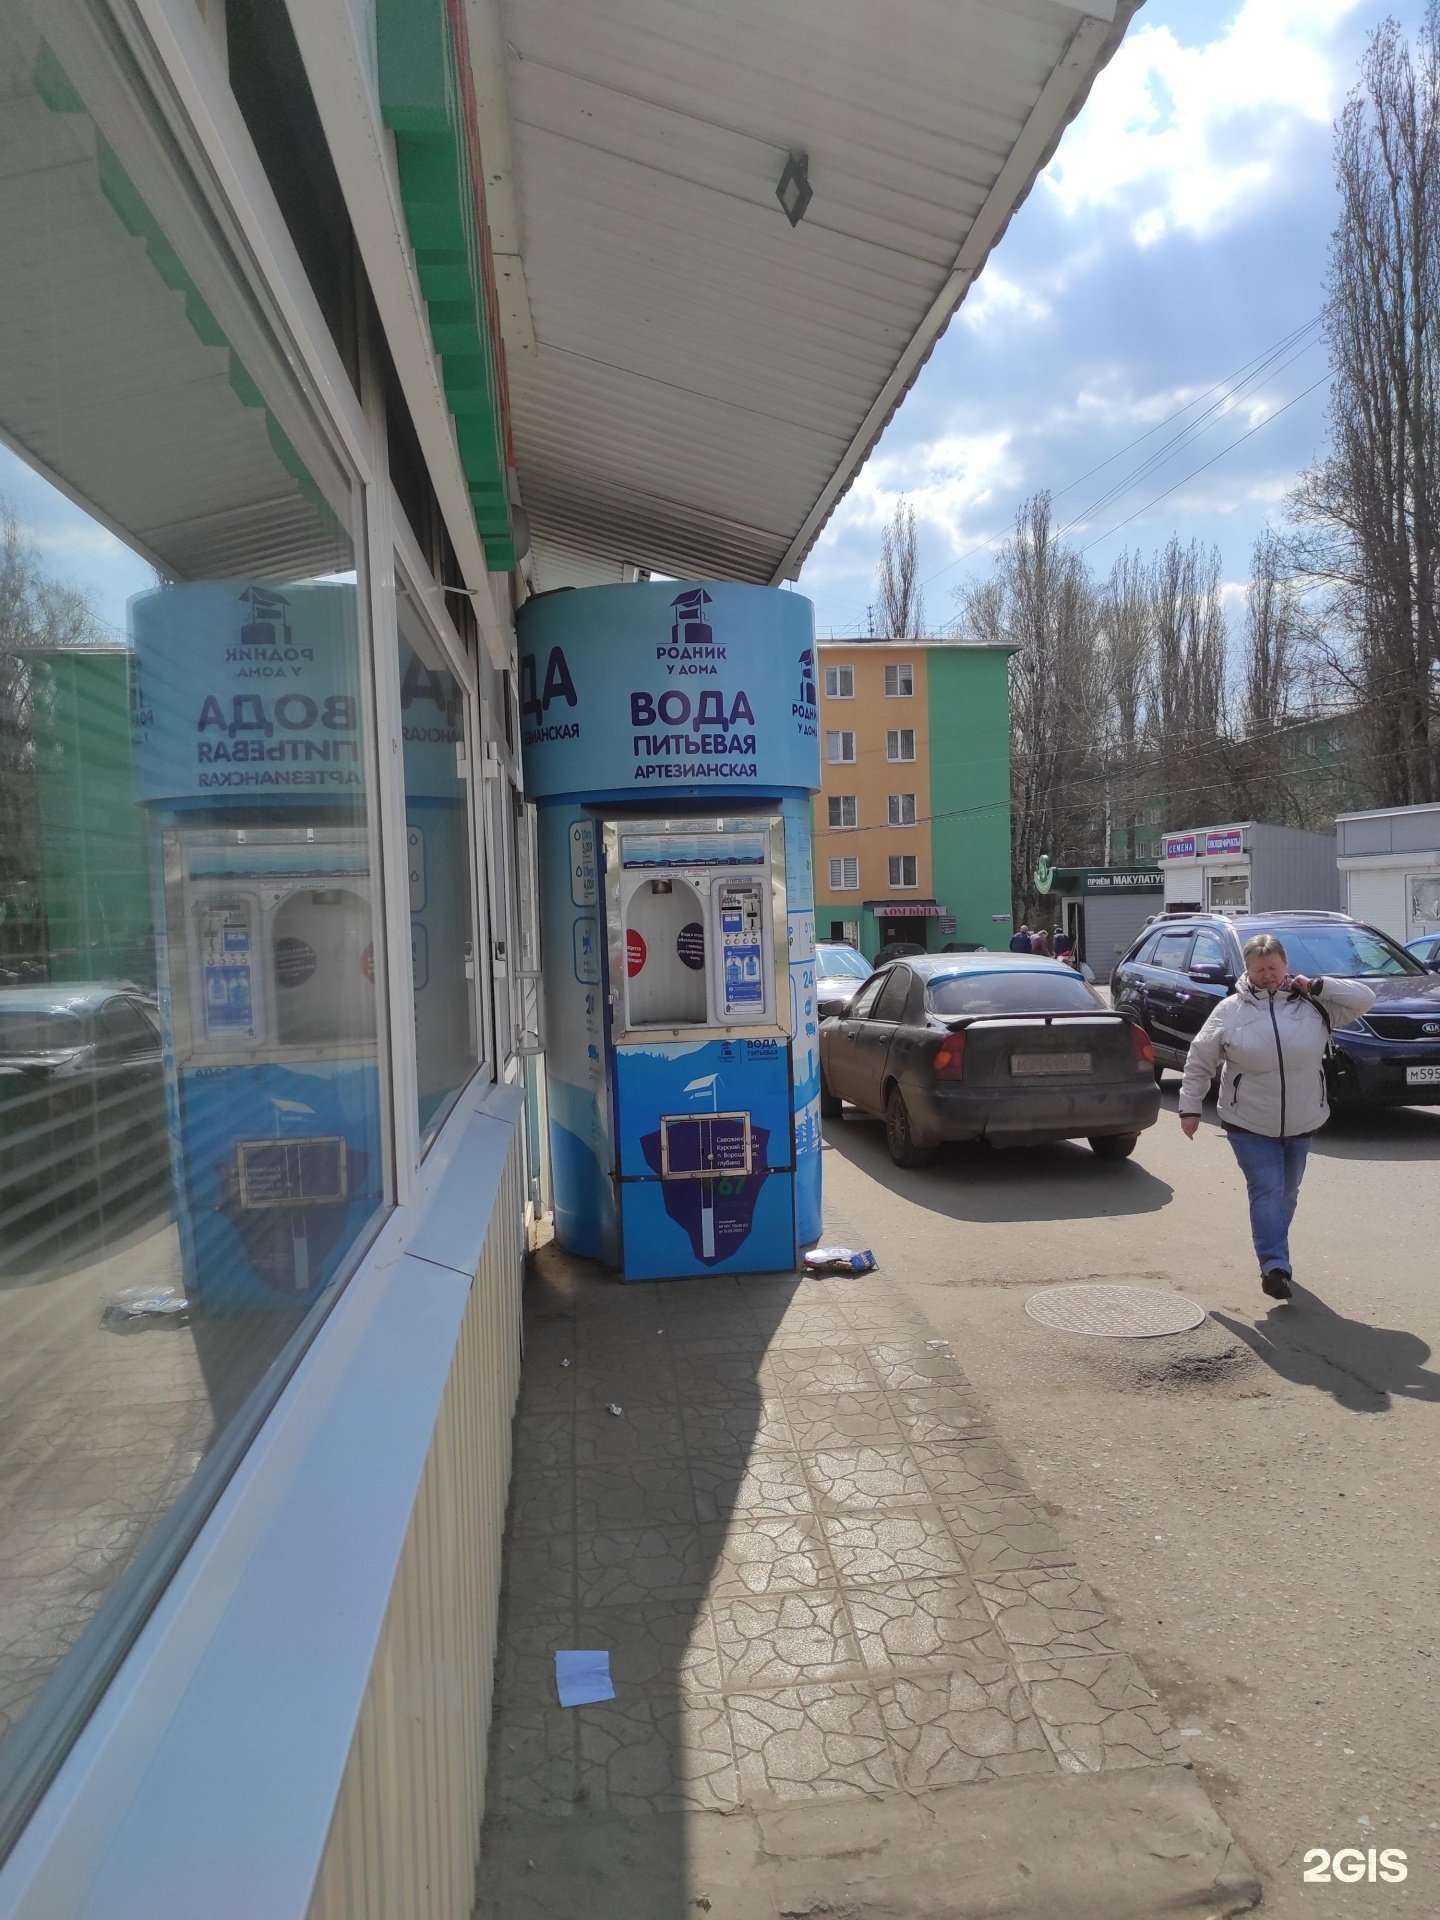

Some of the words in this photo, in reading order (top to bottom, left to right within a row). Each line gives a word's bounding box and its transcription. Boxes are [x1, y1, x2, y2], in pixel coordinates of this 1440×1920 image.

[656, 646, 727, 660] РОДНИК
[666, 664, 674, 675] У
[679, 664, 718, 675] ДОМА
[630, 690, 755, 732] ВОДА
[633, 733, 756, 757] ПИТЬЕВАЯ
[634, 762, 757, 780] АРТЕЗИАНСКАЯ
[1168, 844, 1193, 854] СЕМЕНА
